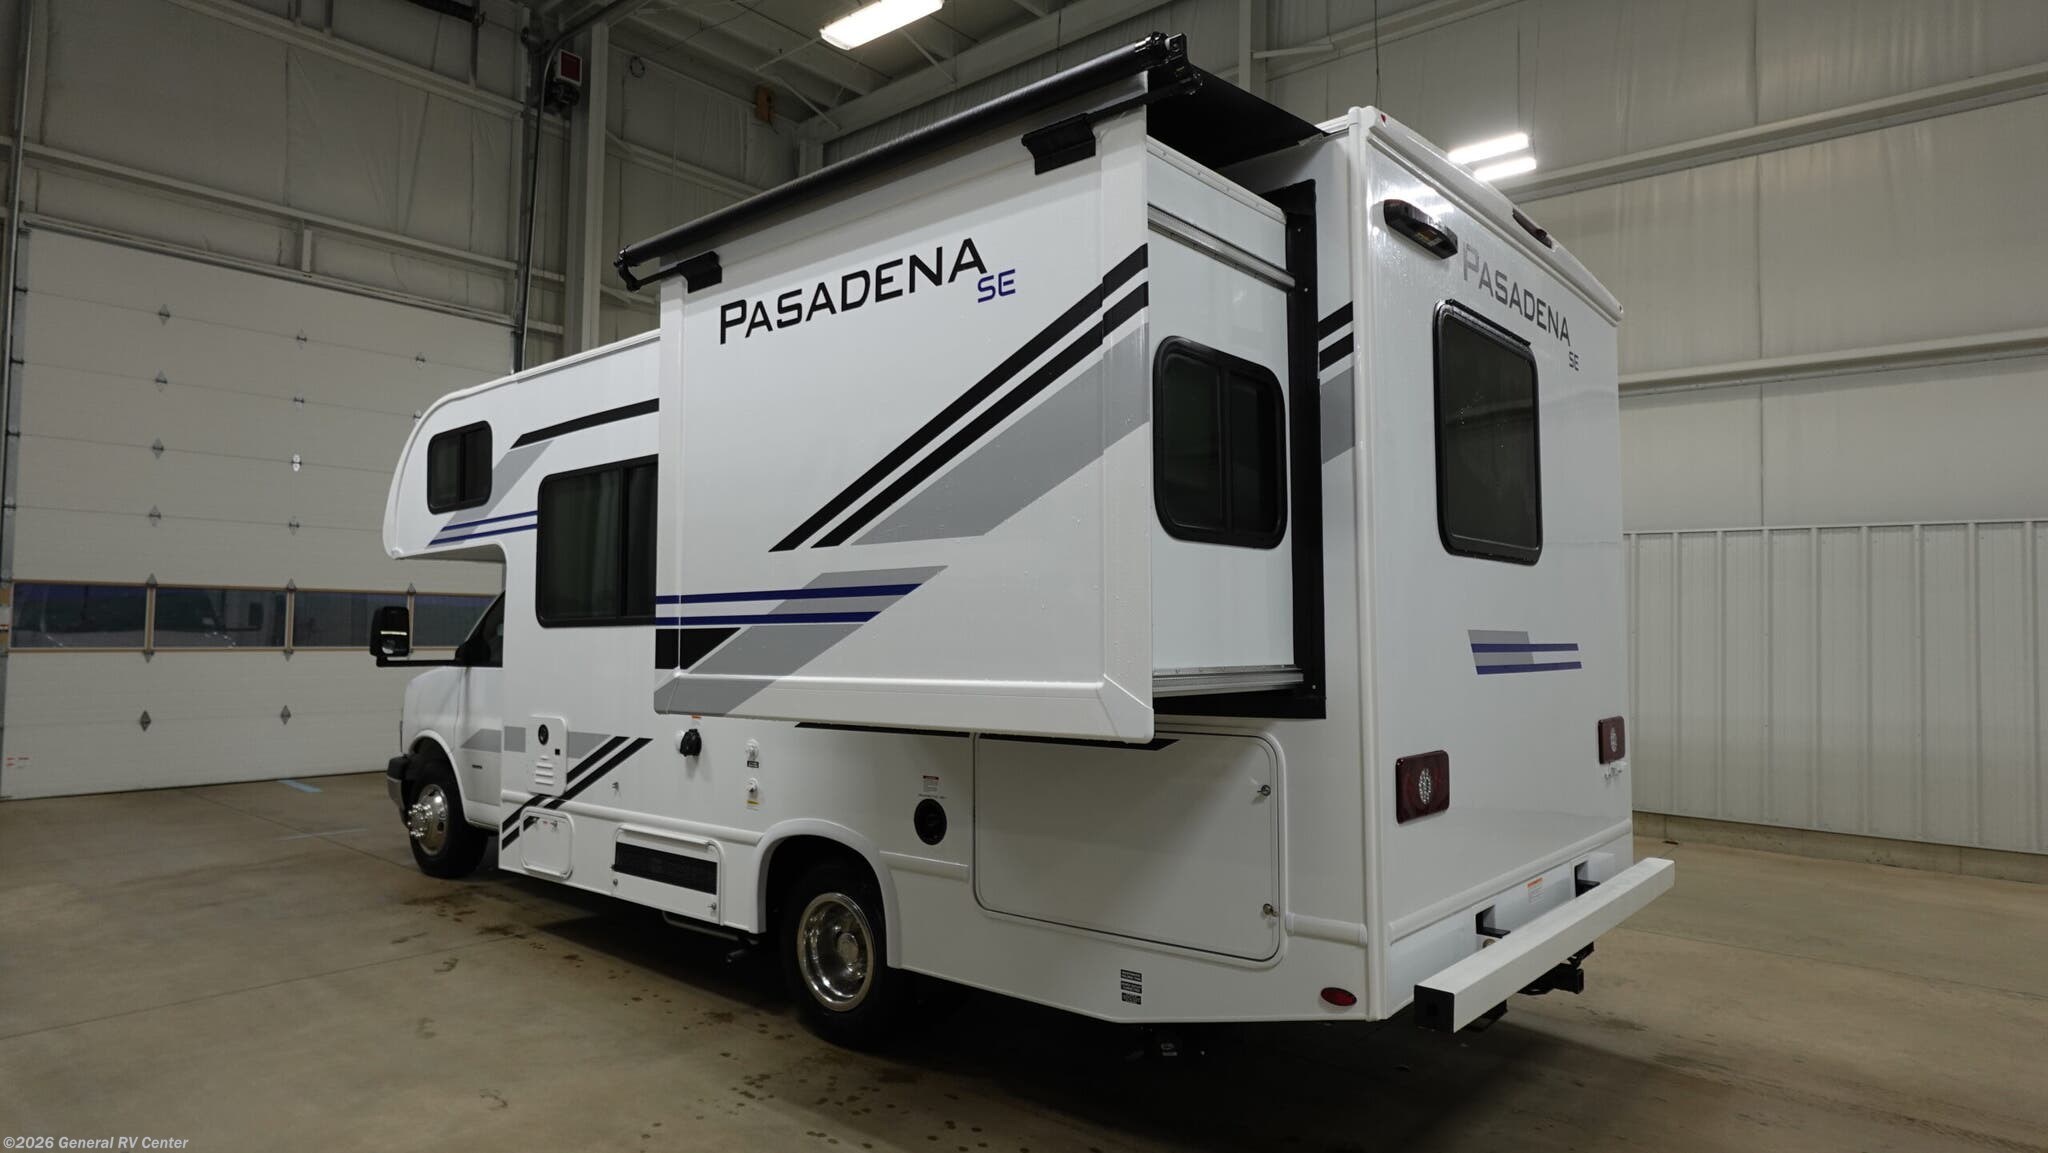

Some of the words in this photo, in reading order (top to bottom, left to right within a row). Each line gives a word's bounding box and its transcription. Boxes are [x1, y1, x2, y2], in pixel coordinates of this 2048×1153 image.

[720, 237, 988, 345] PASADENA
[977, 268, 1016, 303] SE
[1462, 241, 1571, 347] PASADENA
[1568, 351, 1579, 371] SE
